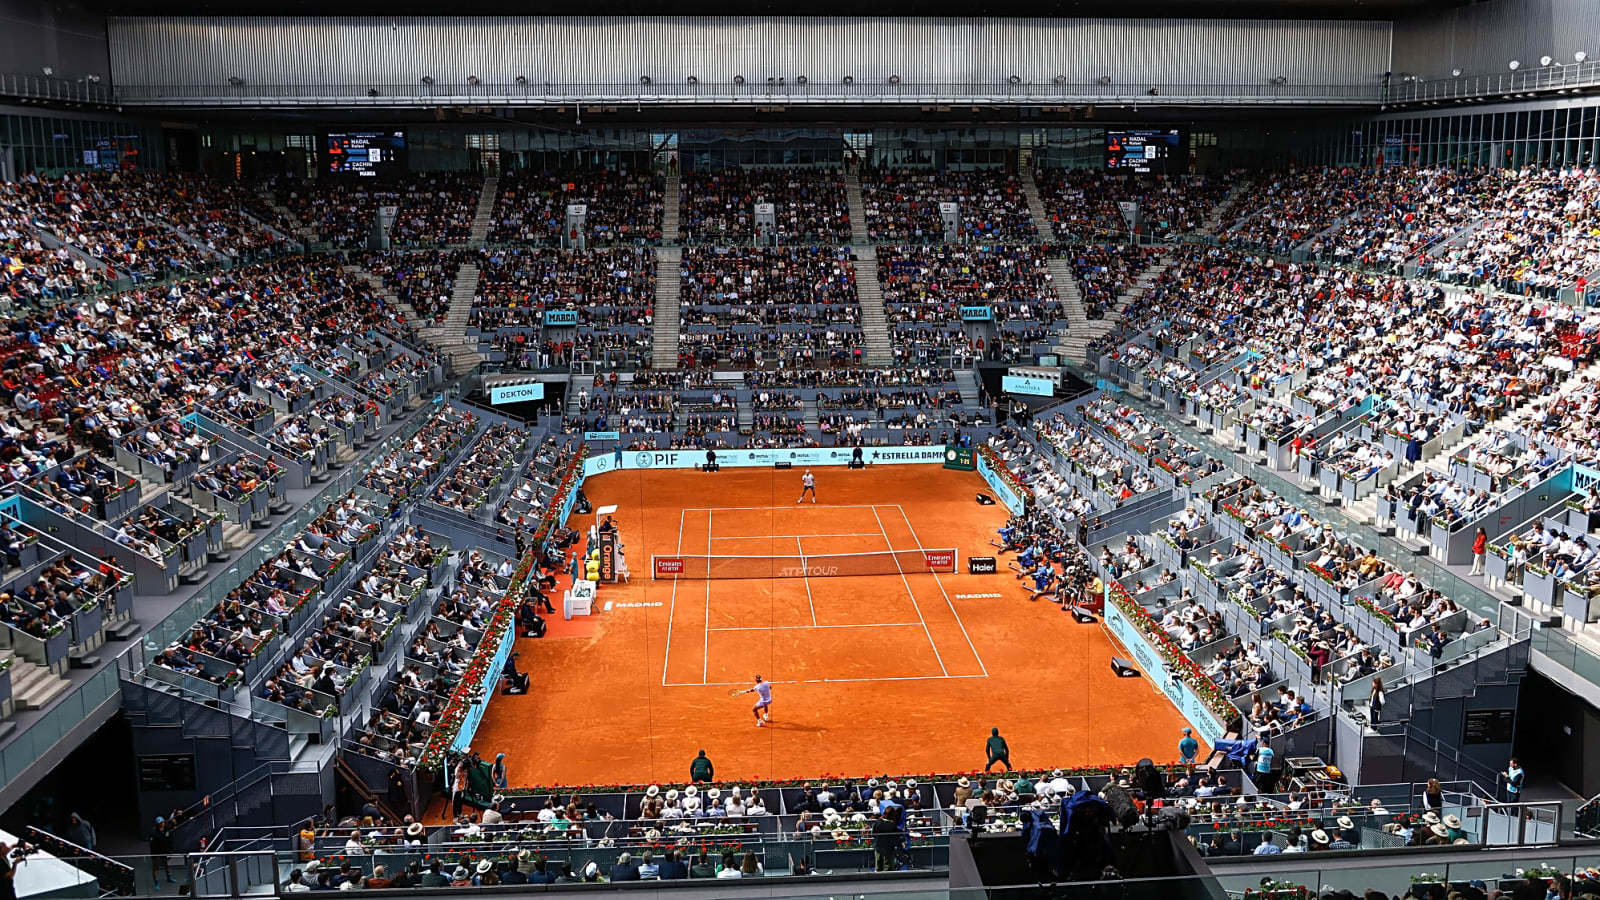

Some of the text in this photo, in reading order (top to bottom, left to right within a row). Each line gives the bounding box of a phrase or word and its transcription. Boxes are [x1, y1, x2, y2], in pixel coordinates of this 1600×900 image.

[548, 314, 576, 322] MARCA
[961, 309, 988, 318] MARCA
[500, 389, 533, 399] DEKTON
[655, 454, 678, 465] PIF
[602, 545, 612, 579] Orange
[807, 566, 838, 575] TOUR
